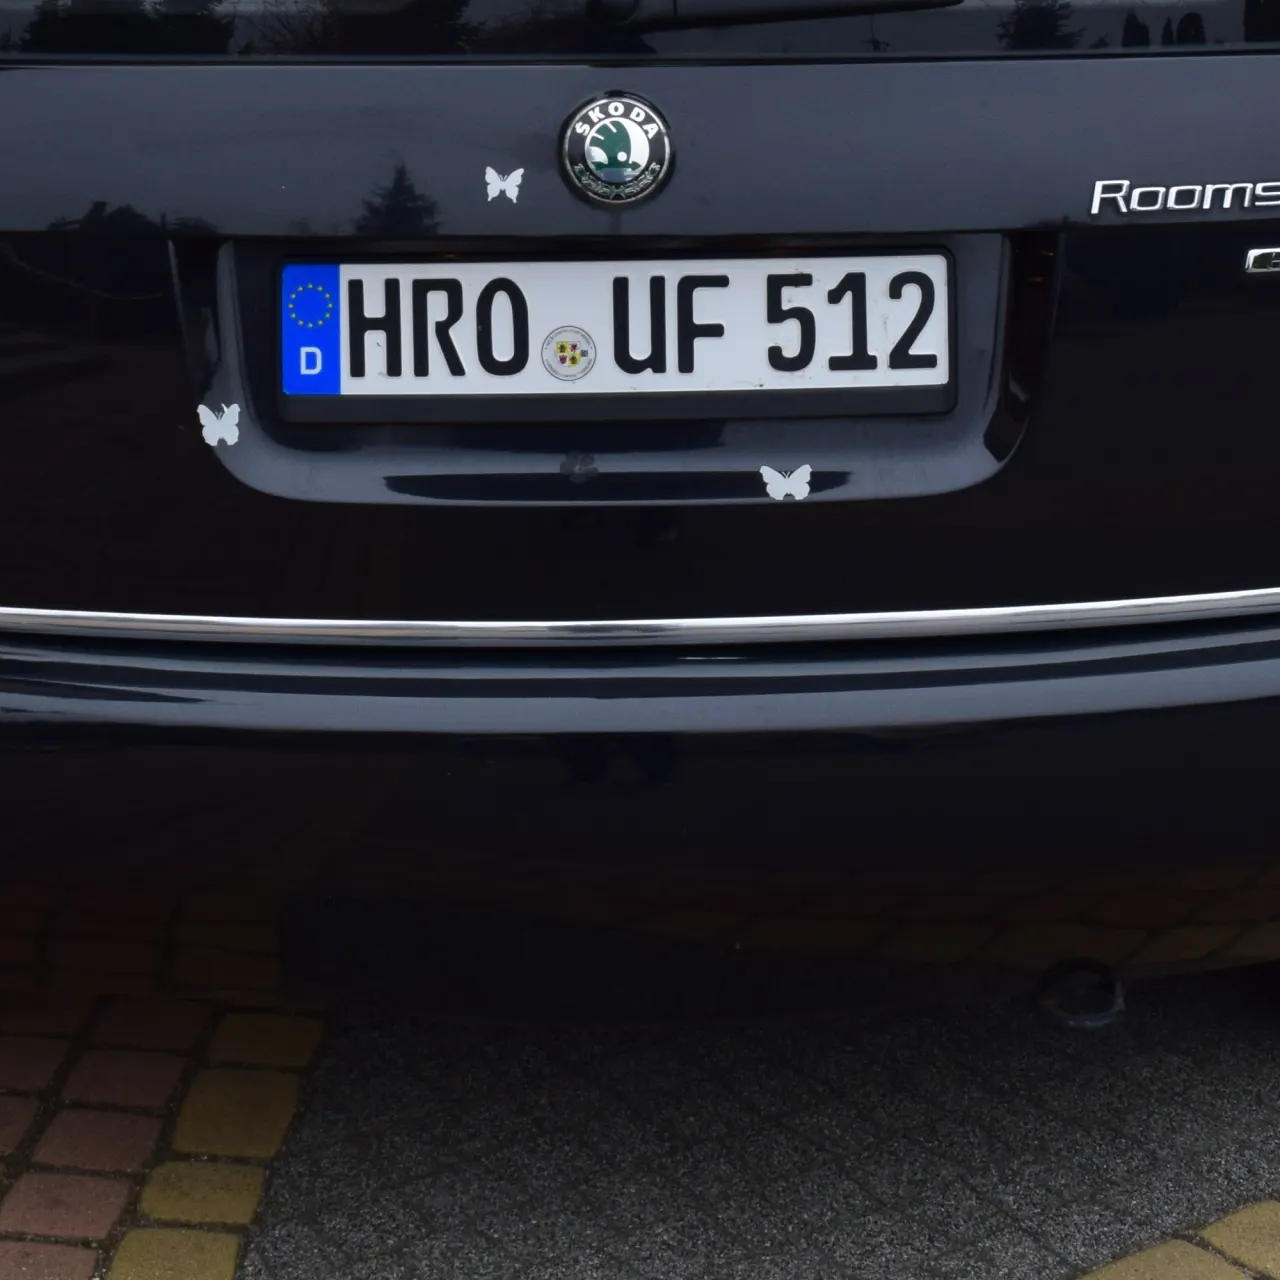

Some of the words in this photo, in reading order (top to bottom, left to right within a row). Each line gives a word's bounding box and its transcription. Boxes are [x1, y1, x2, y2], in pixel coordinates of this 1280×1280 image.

[347, 276, 530, 378] HRO
[612, 274, 730, 375] UF
[766, 271, 938, 372] 512
[299, 346, 322, 375] D
